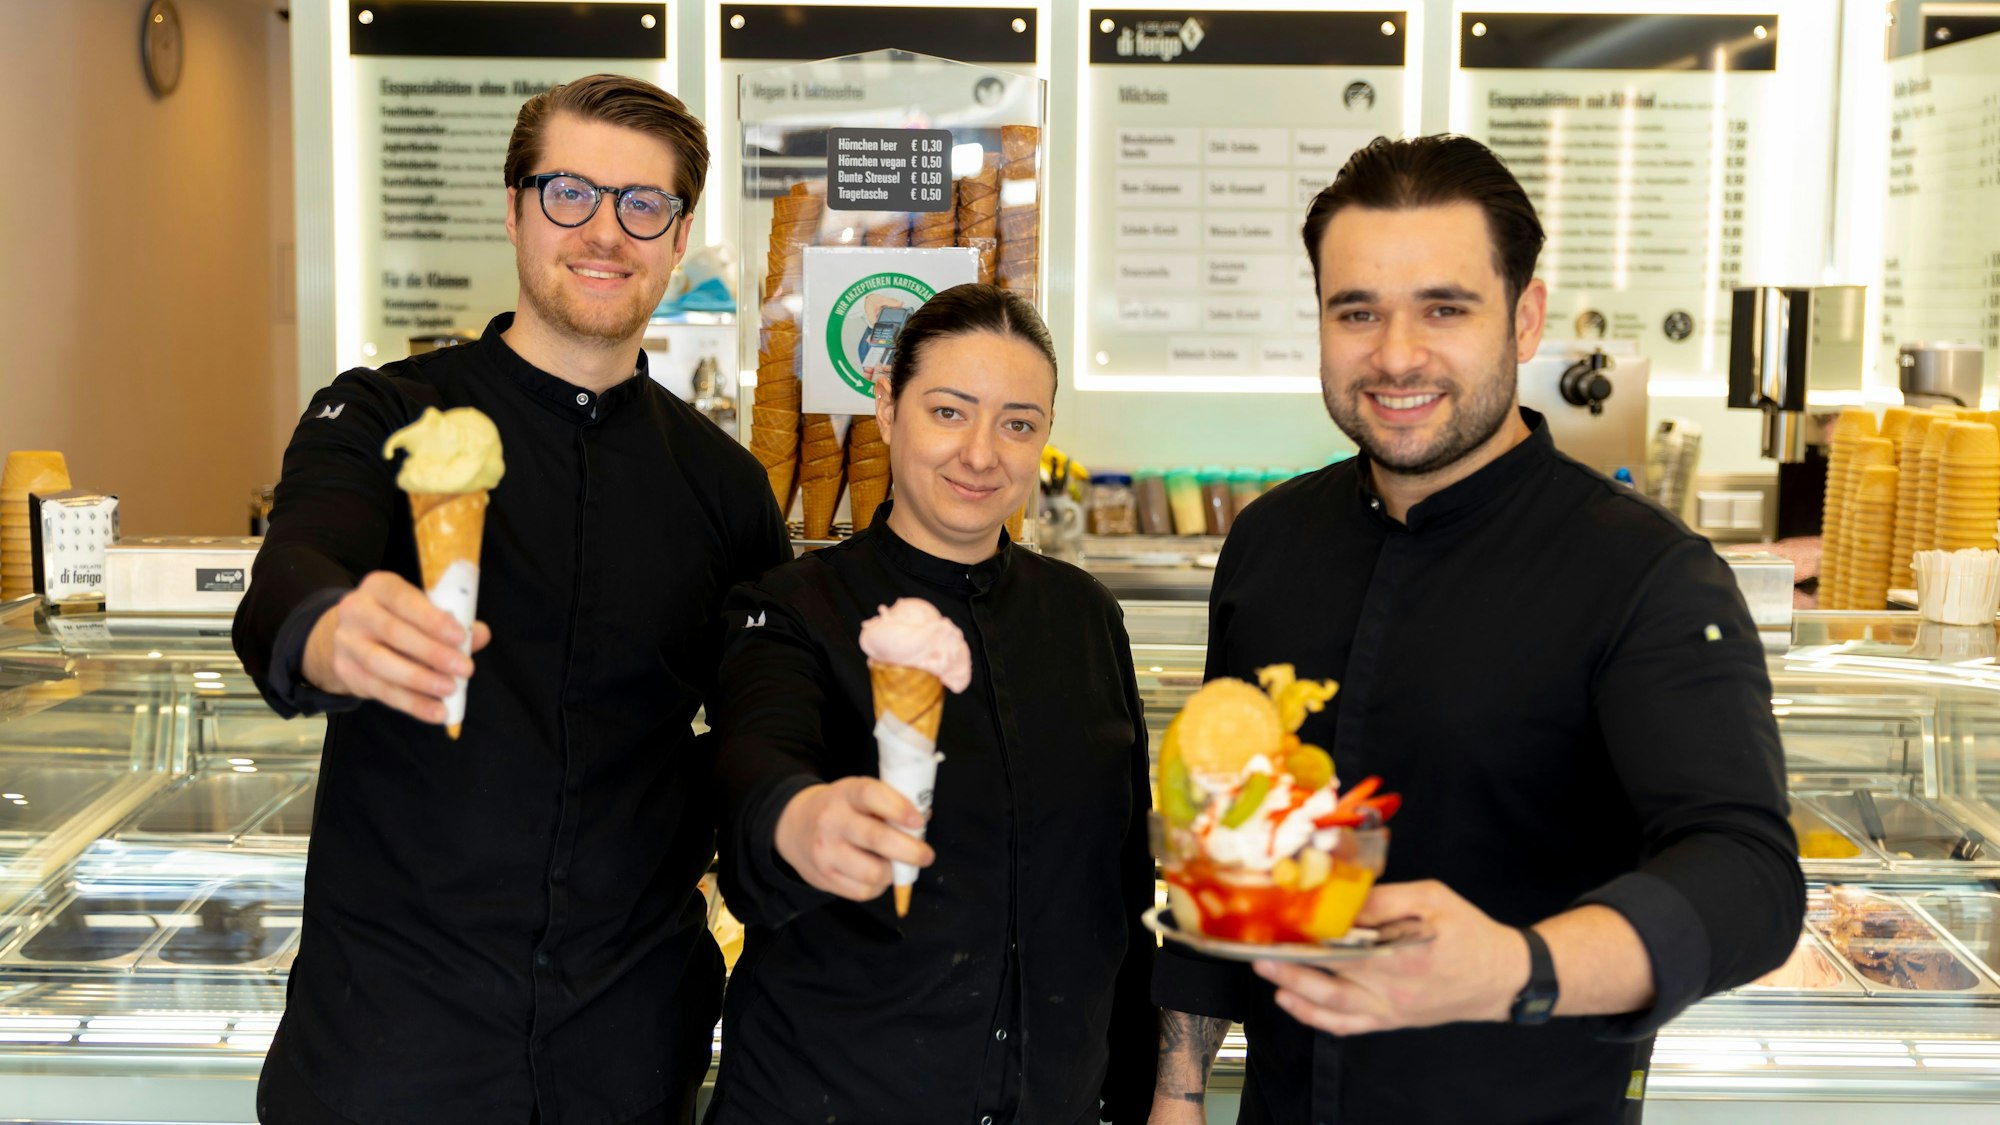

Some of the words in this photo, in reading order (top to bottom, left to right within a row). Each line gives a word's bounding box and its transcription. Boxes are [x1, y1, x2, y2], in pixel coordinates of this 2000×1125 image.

[838, 138, 878, 151] Hörnchen
[880, 138, 898, 152] leer
[911, 139, 918, 152] €
[921, 139, 943, 153] 0,30
[838, 154, 878, 167] Hörnchen
[880, 157, 906, 170] vegan
[911, 155, 918, 168] €
[921, 155, 942, 169] 0,50
[838, 170, 863, 183] Bunte
[865, 171, 900, 184] Streusel
[911, 172, 917, 184] €
[921, 172, 942, 185] 0,50
[837, 187, 889, 202] Tragetasche
[910, 188, 917, 201] €
[921, 188, 942, 202] 0,50
[834, 300, 849, 316] WIR
[844, 276, 892, 304] AKZEPTIEREN
[60, 568, 69, 584] di
[73, 570, 102, 587] ferigo
